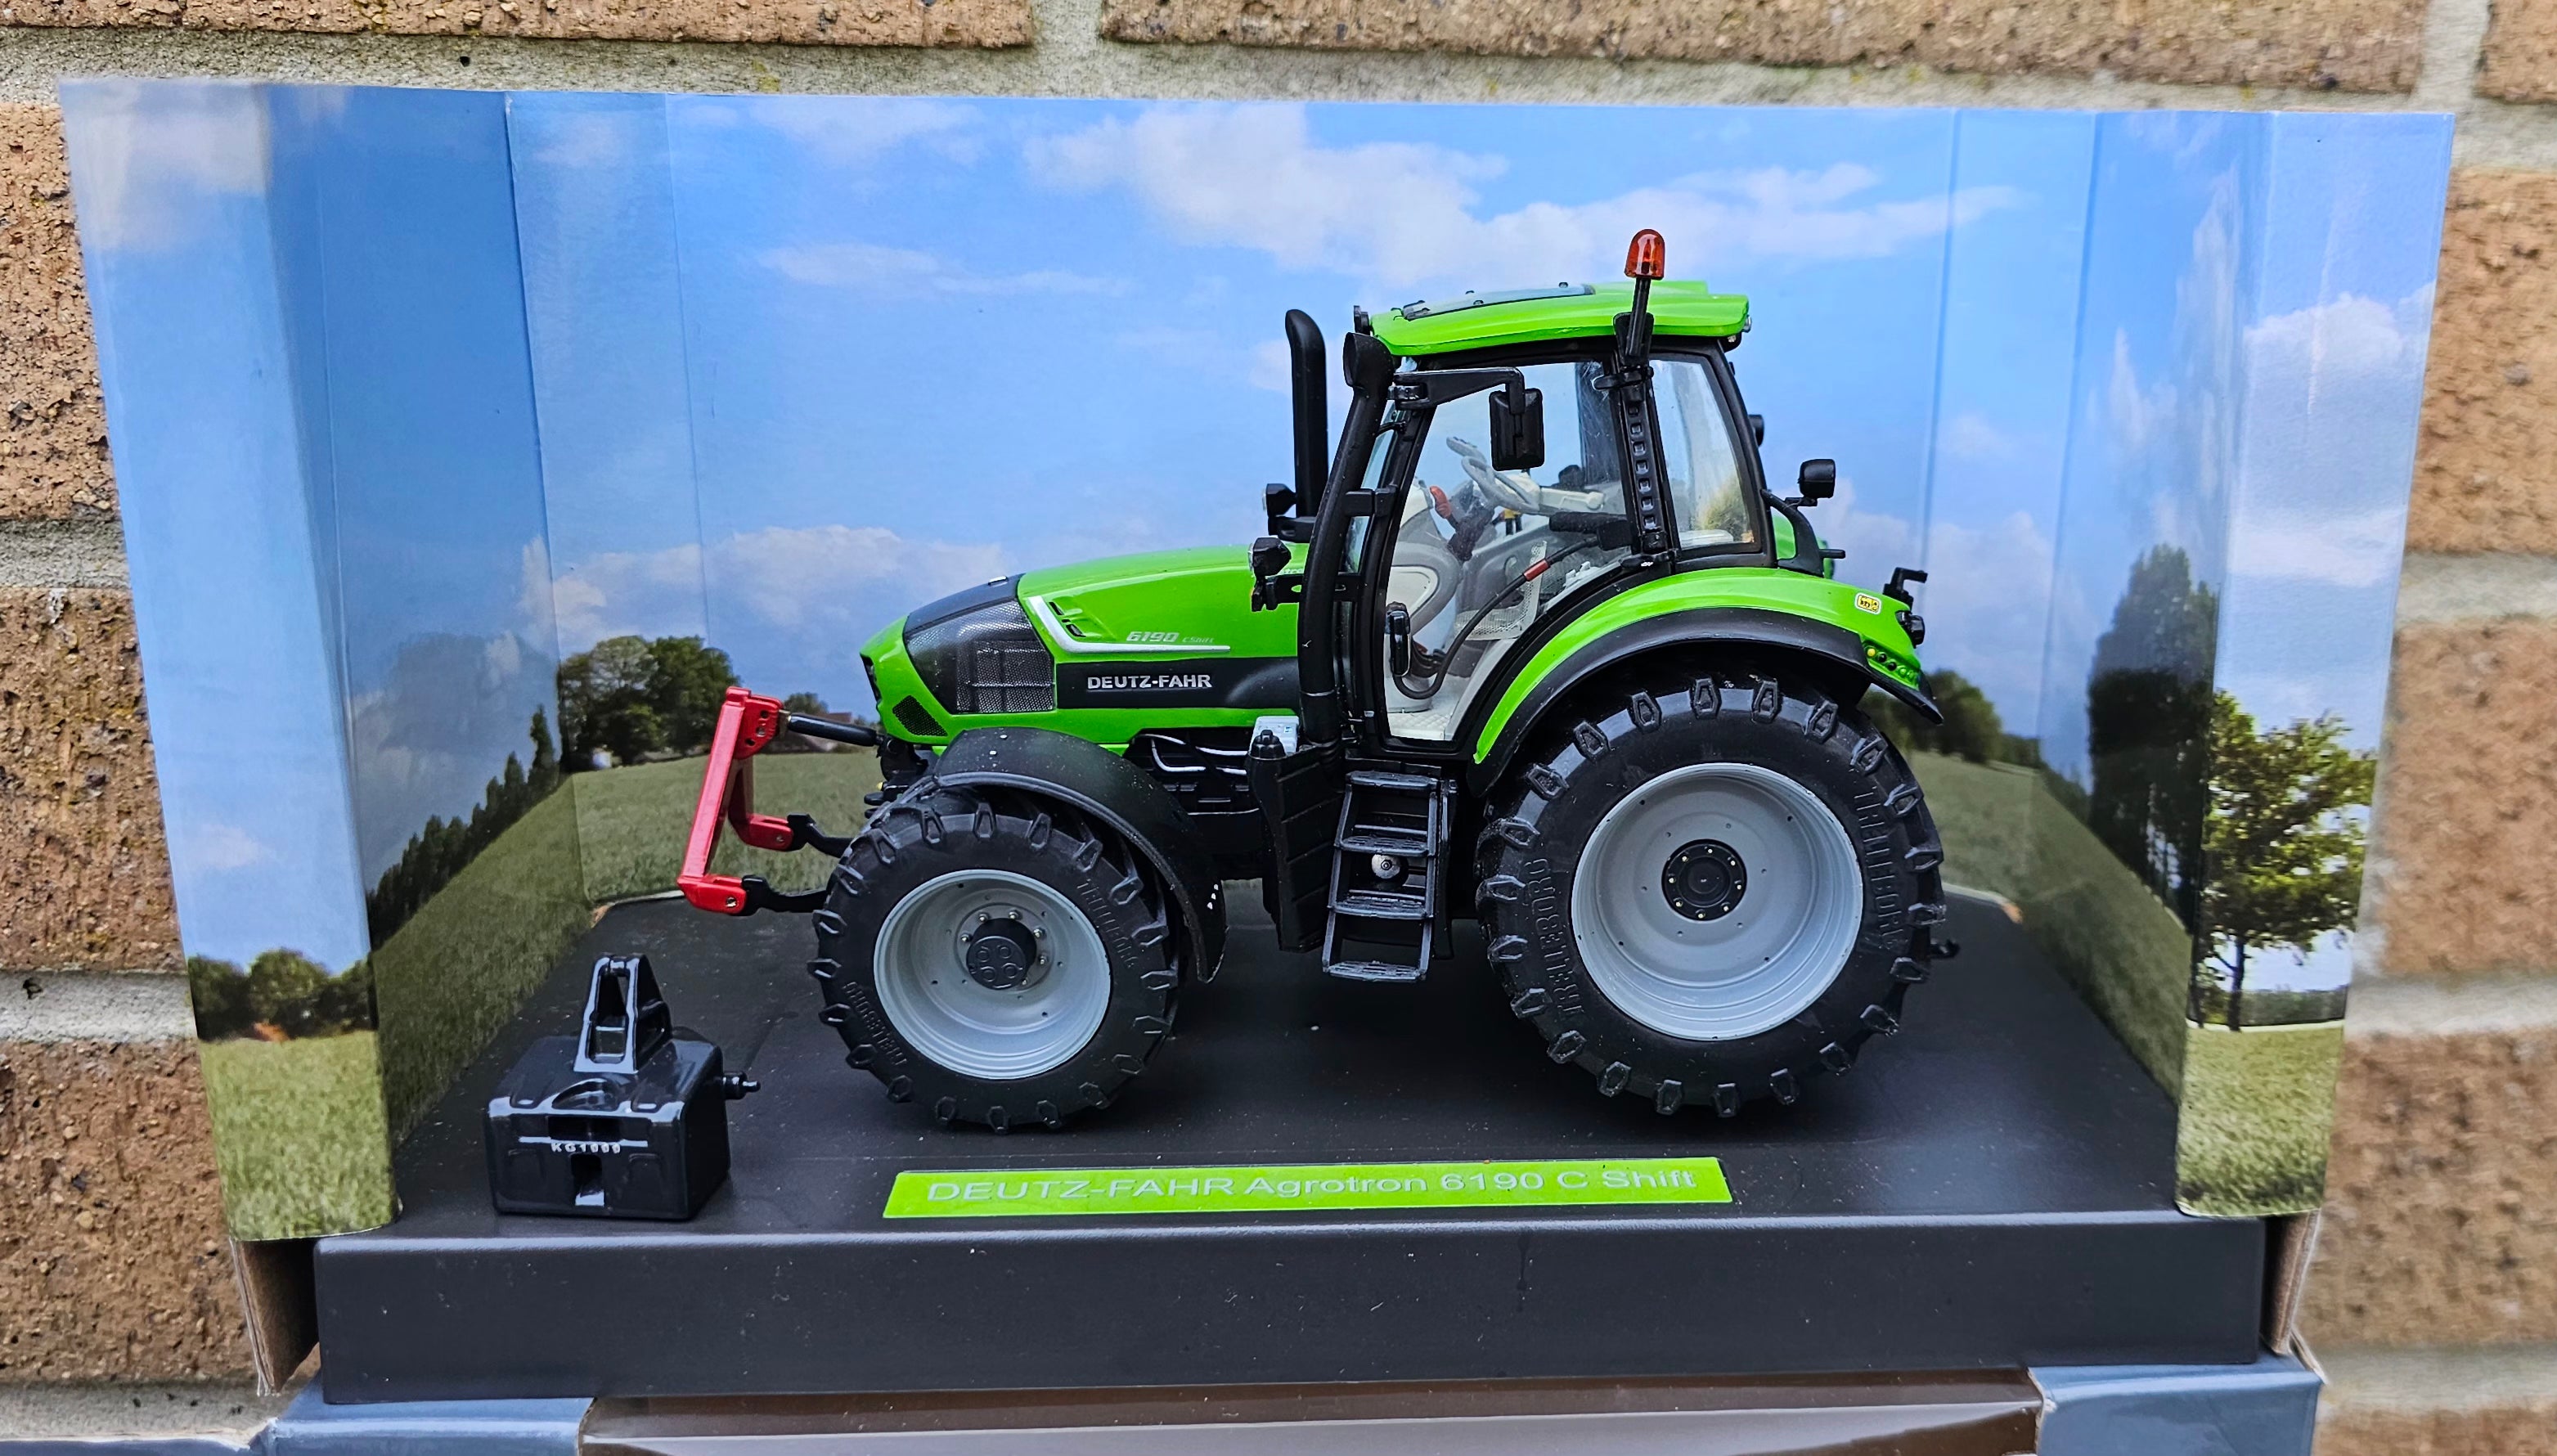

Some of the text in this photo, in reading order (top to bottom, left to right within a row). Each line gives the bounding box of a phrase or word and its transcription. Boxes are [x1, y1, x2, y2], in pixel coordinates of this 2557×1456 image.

[1126, 631, 1180, 642] 6190
[1087, 674, 1212, 690] DEUTZ-FAHR
[1524, 858, 1584, 1016] TRELLEBORG
[927, 1169, 1698, 1202] DEUTZ-FAHR Agrotron 6190 C Shift
